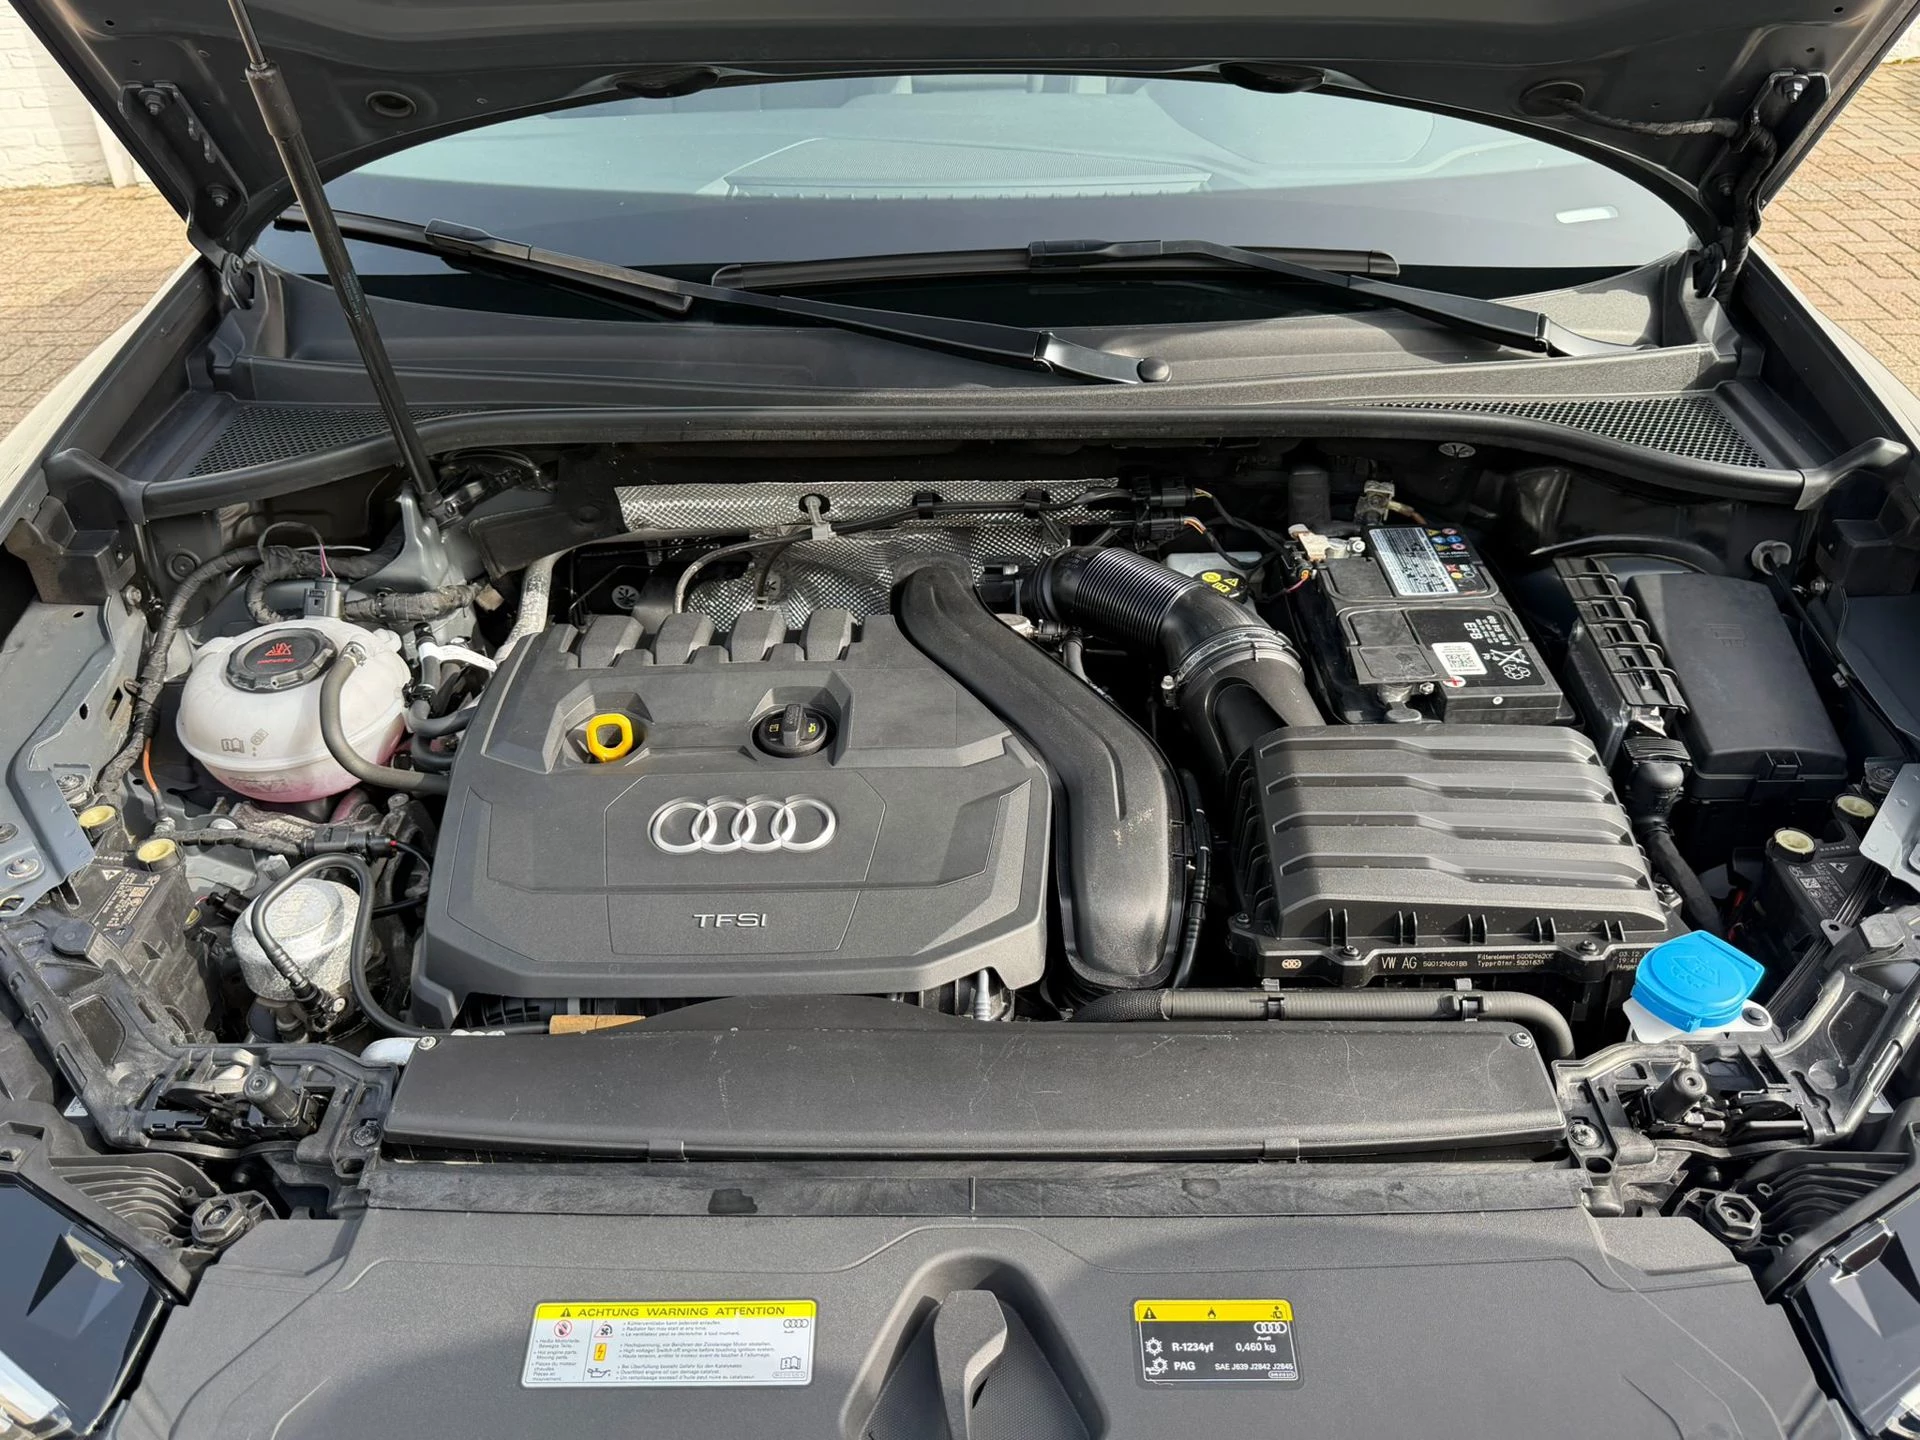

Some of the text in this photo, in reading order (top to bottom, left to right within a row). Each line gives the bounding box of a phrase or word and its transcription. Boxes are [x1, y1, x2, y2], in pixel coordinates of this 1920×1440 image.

[693, 913, 767, 928] TFSI
[1381, 956, 1397, 969] VW
[1401, 956, 1418, 969] AG
[577, 1306, 786, 1317] ACHTUNG WARNING ATTENTION
[1171, 1342, 1277, 1354] R-1234yf 0,460 kg
[1173, 1361, 1196, 1371] PAG
[1214, 1363, 1231, 1371] SAE
